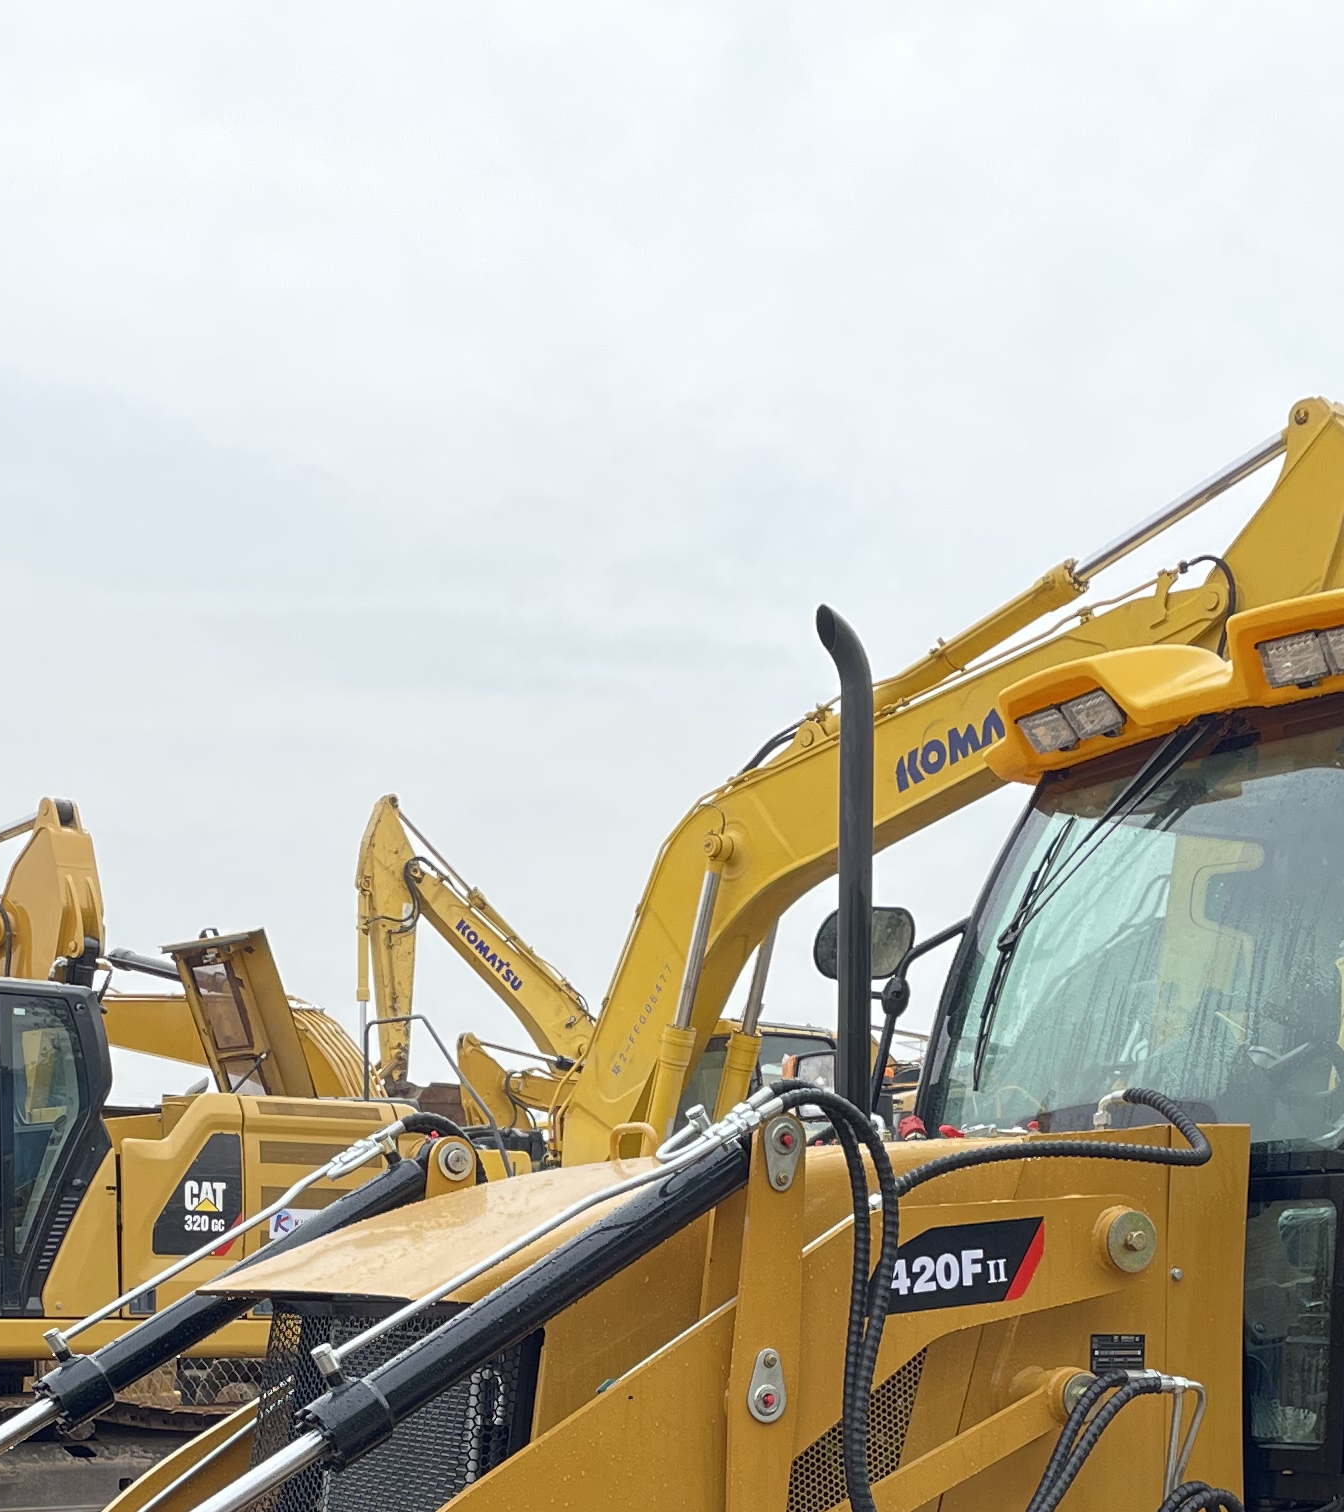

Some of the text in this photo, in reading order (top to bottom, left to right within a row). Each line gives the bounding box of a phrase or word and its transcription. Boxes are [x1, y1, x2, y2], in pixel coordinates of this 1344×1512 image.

[456, 918, 522, 991] KOMATSU
[184, 1180, 226, 1212] CAT
[184, 1215, 225, 1232] 320 GC
